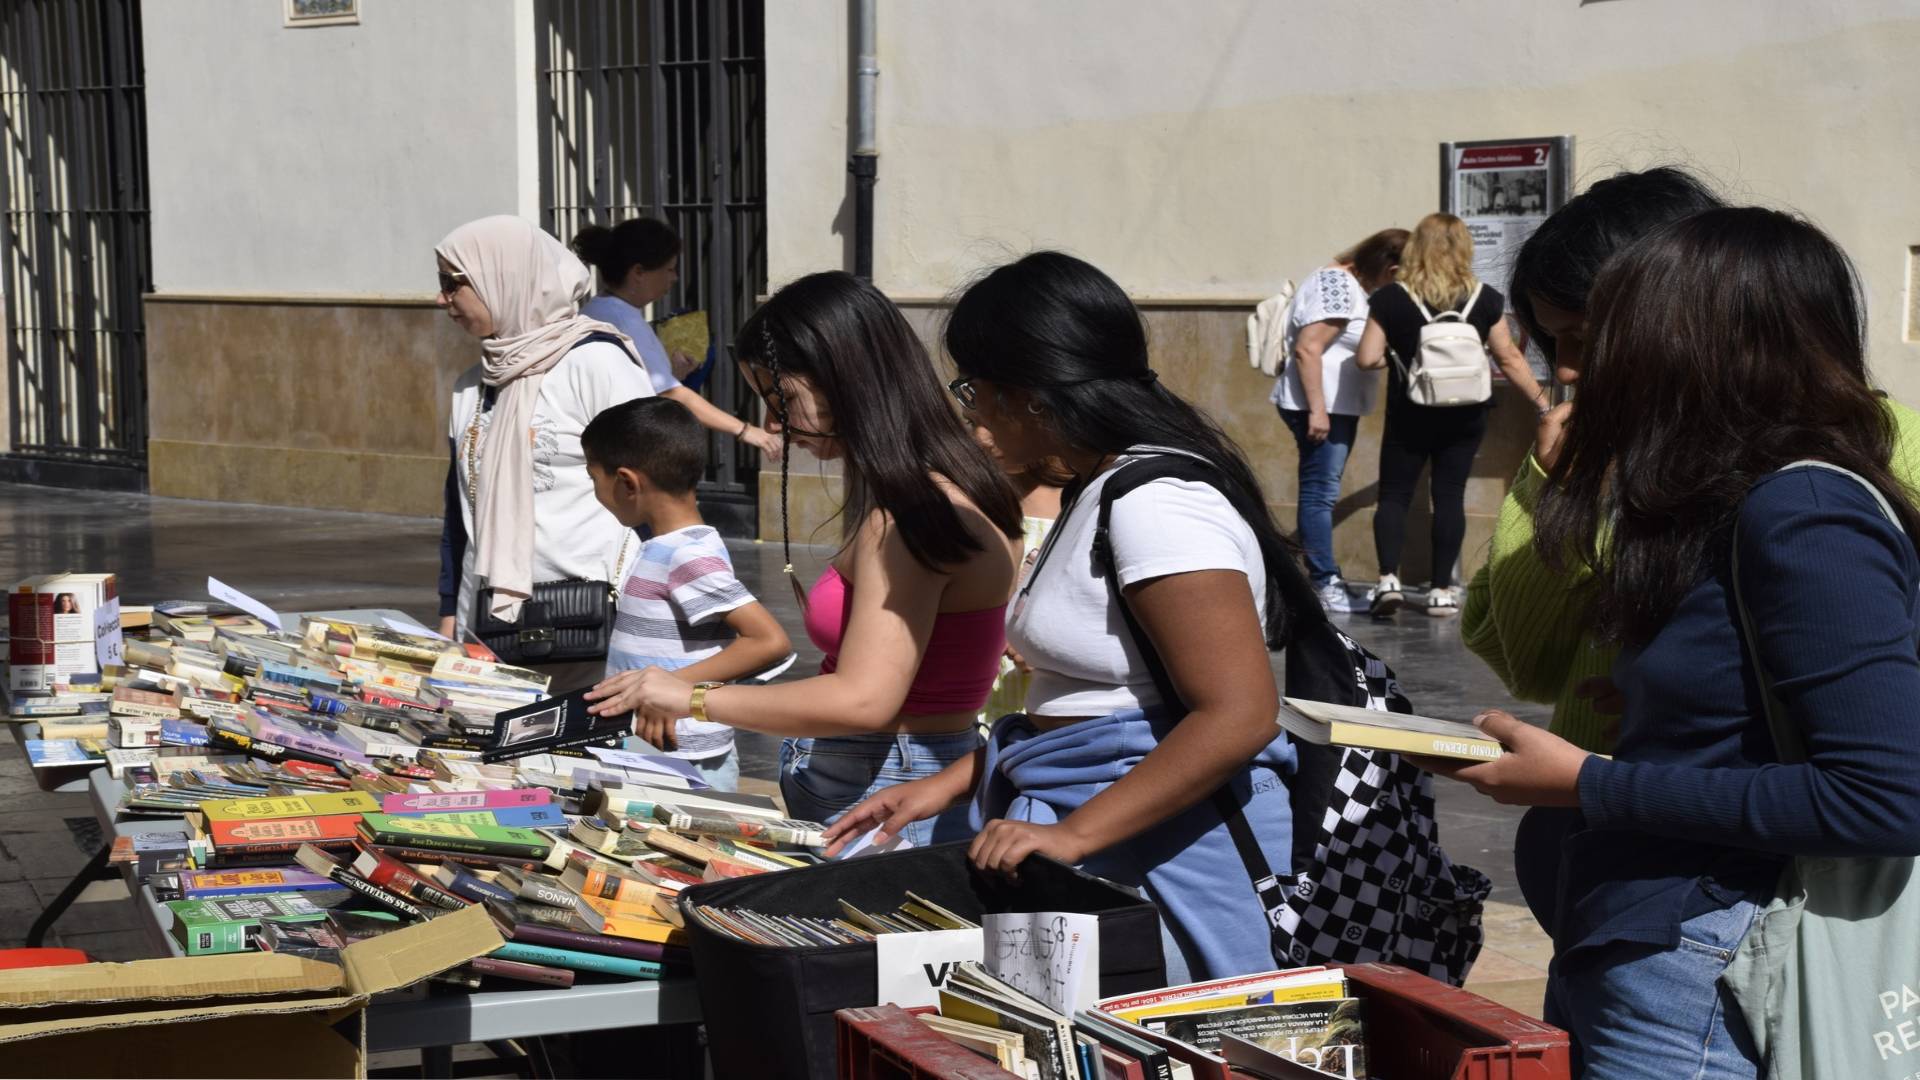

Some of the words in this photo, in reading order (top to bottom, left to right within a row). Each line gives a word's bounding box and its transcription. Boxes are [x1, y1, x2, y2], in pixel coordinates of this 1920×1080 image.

[1534, 148, 1545, 164] 2
[353, 877, 395, 904] SEXUALES
[1879, 983, 1920, 1020] PA
[1233, 1025, 1257, 1033] CONTRA
[1258, 1022, 1288, 1030] CRISTIANA
